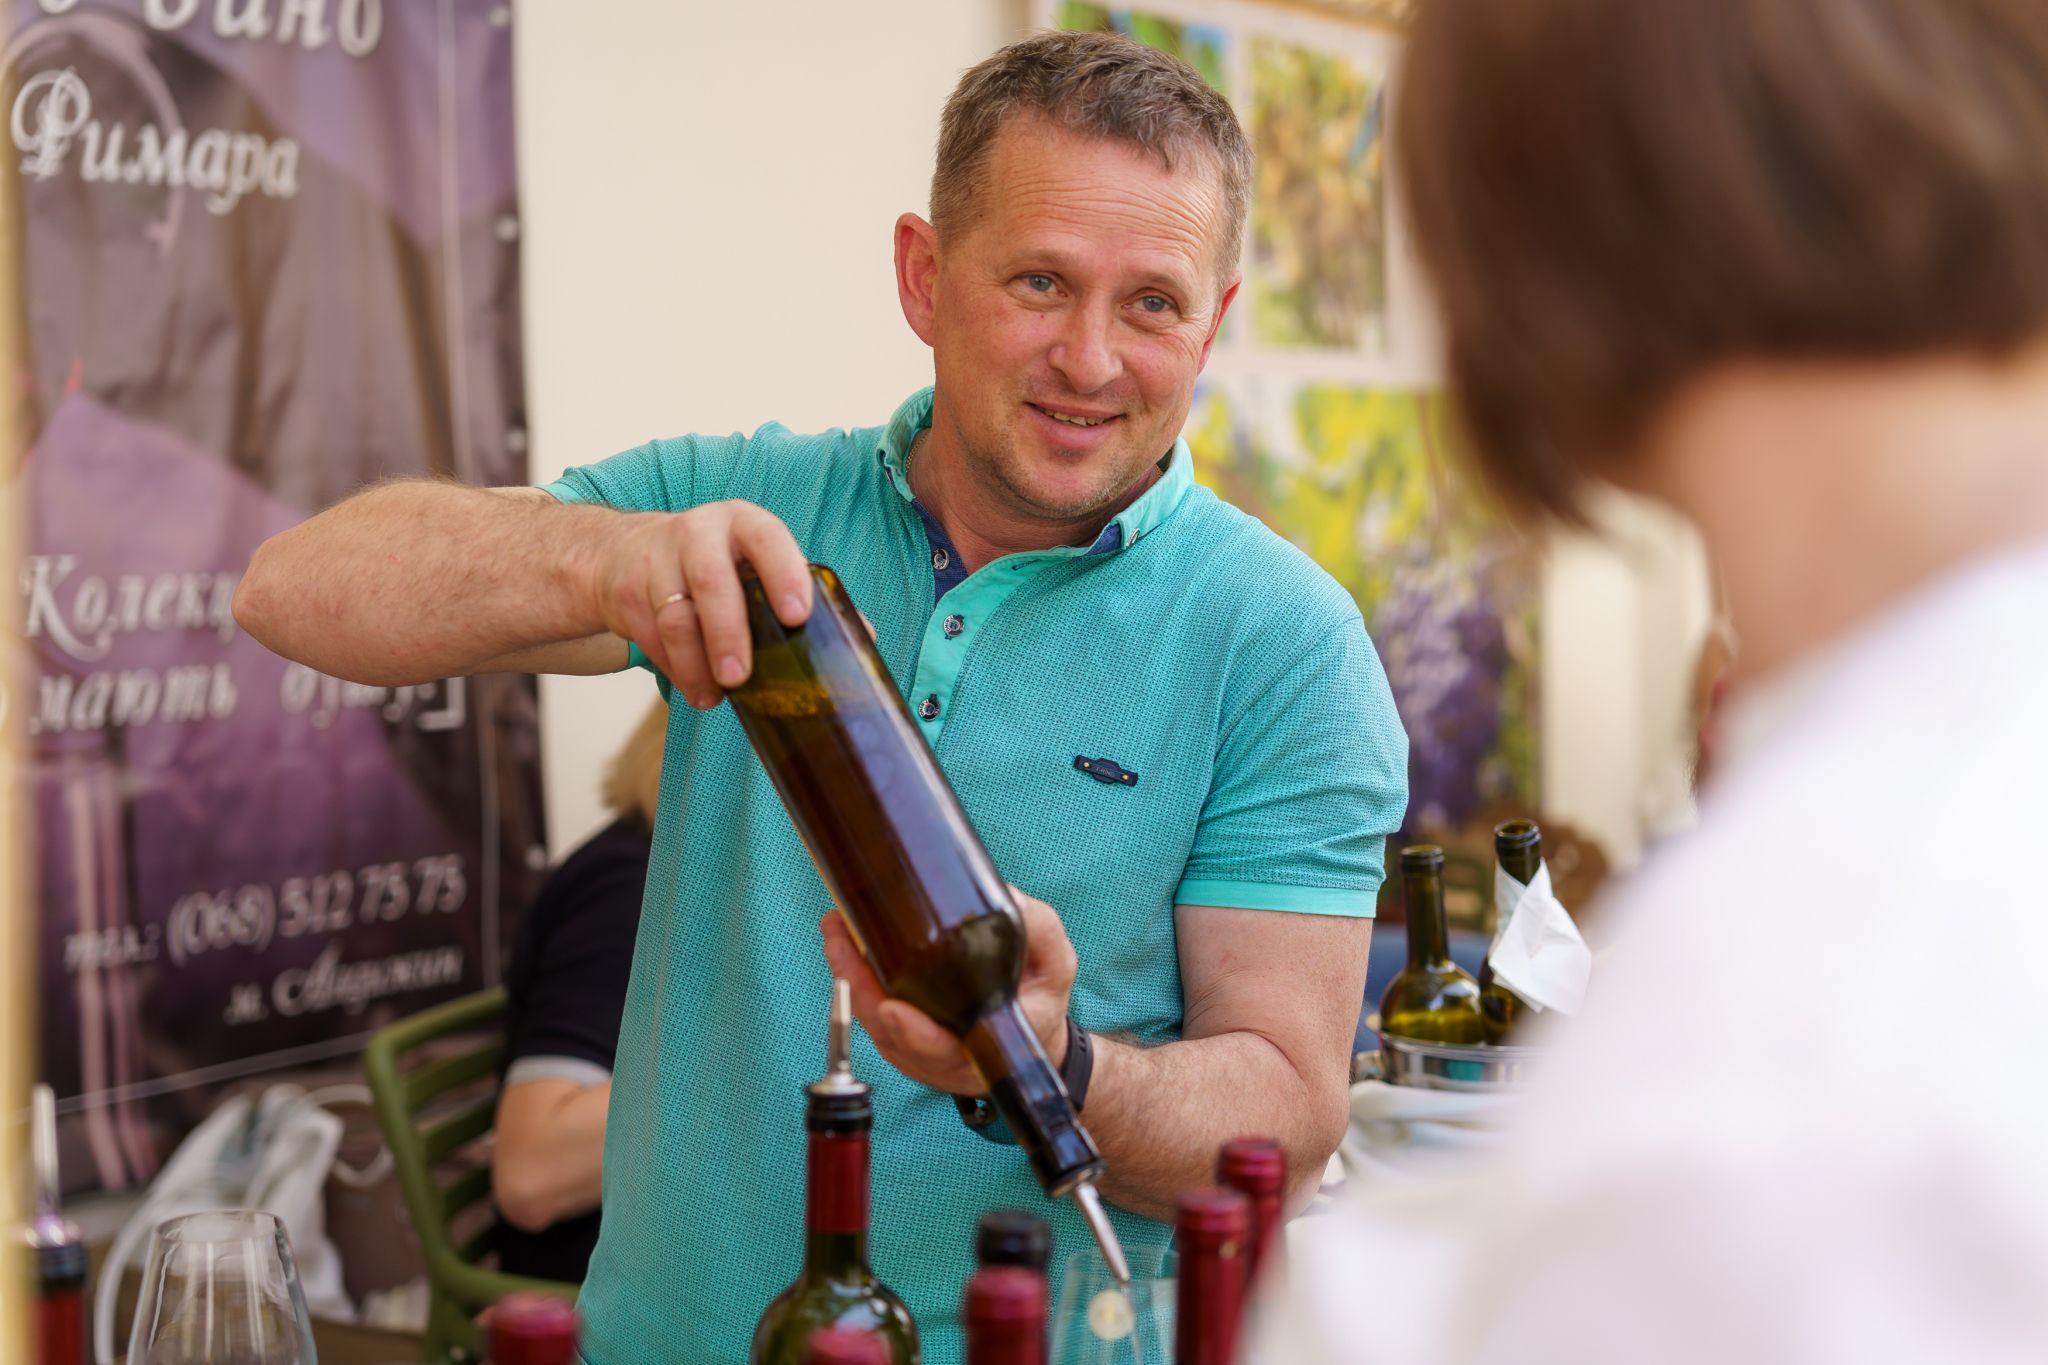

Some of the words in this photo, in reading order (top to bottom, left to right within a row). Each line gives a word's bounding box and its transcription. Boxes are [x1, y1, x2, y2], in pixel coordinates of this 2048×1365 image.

[10, 67, 302, 217] Римара
[24, 553, 241, 662] Колекц
[280, 869, 354, 938] 512
[358, 861, 411, 923] 75
[412, 852, 467, 914] 75
